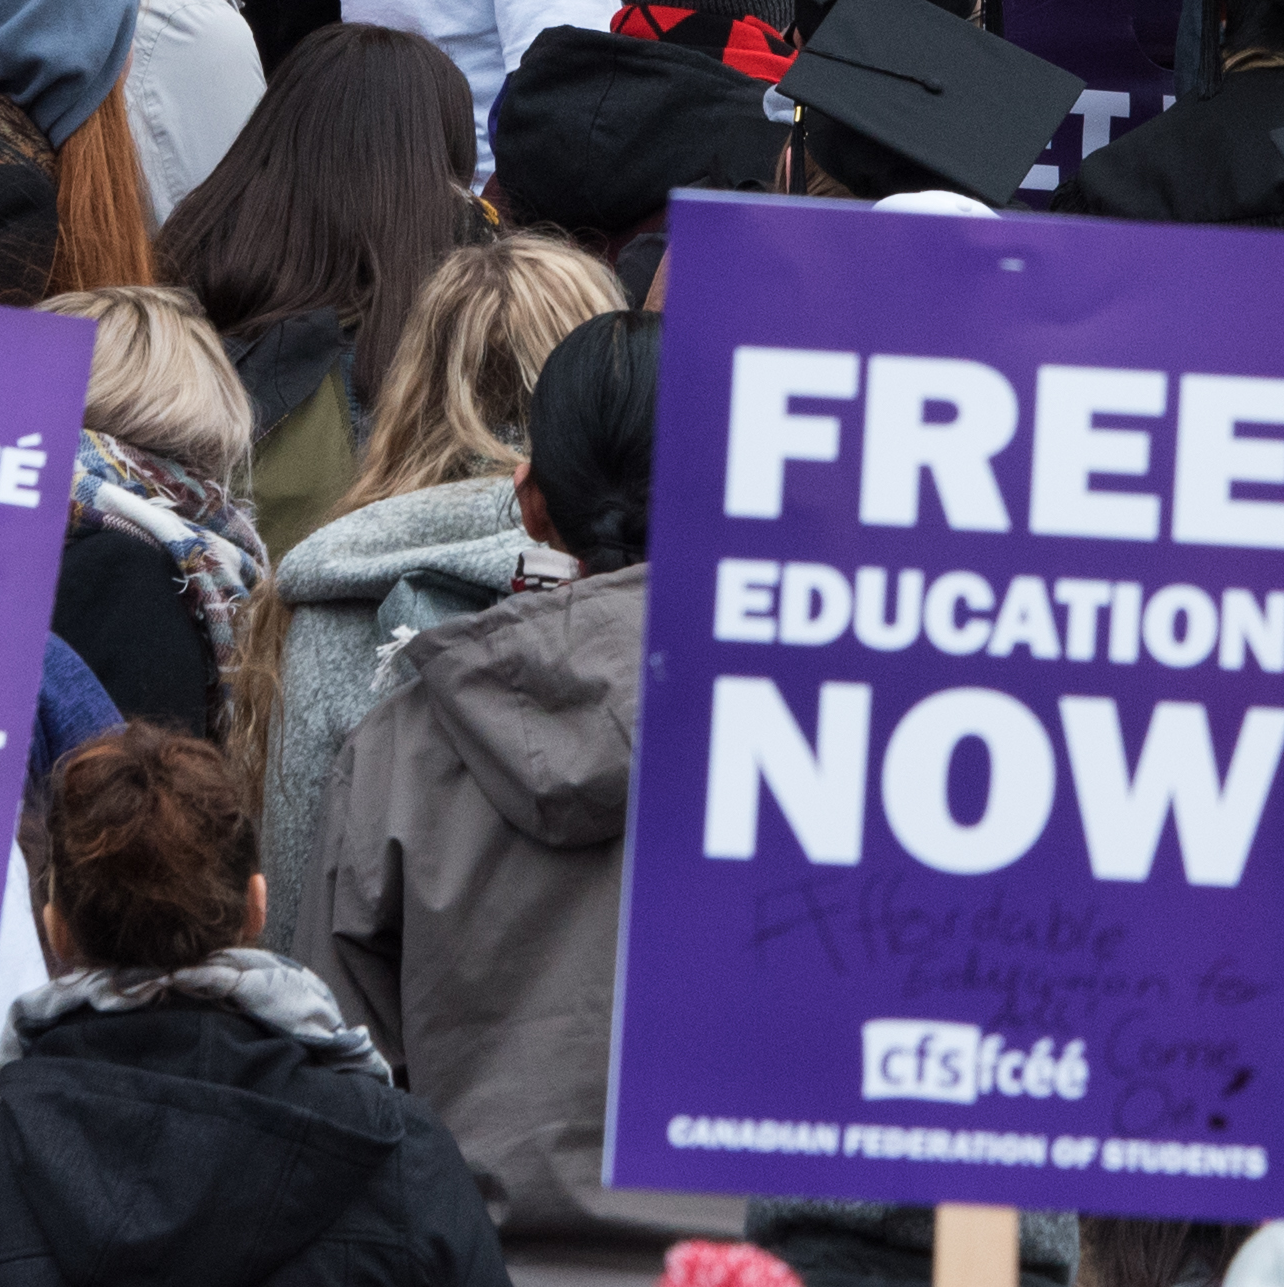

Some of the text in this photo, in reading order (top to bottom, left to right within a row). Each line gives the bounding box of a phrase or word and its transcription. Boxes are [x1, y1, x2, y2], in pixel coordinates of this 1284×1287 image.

[667, 1114, 1268, 1179] CANADIAN FEDERATION OF STUDENTS
